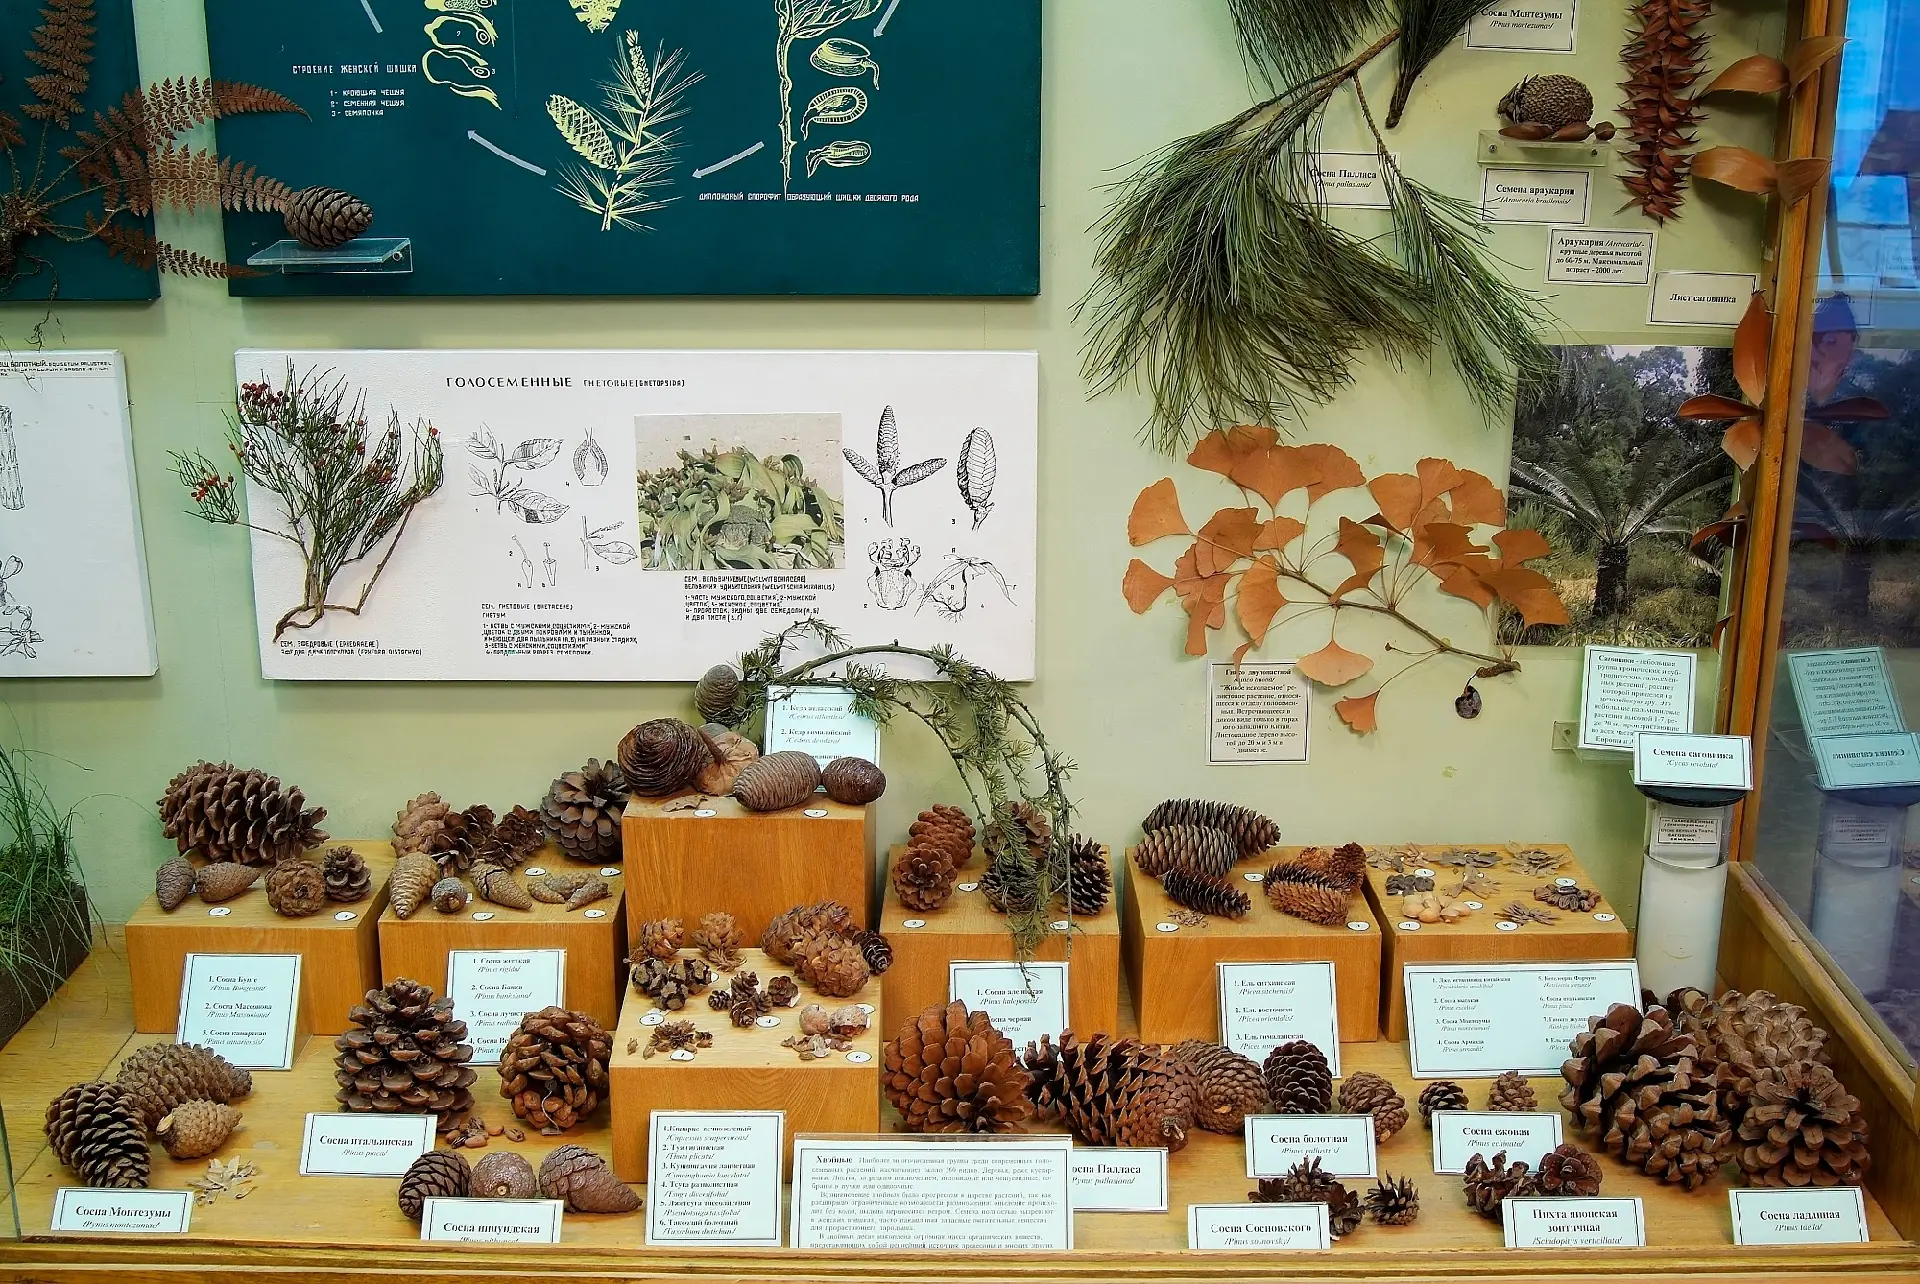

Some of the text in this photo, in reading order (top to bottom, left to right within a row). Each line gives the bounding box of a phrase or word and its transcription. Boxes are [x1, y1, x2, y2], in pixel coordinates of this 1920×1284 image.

[1481, 9, 1562, 20] Сосна Монтезумы
[293, 62, 417, 74] СТРОЕНИЕ ЖЕНСКОЙ ШИШКИ
[1496, 185, 1574, 196] Семена араукарии
[901, 194, 919, 202] РОДА
[1558, 238, 1603, 248] Араукария
[446, 377, 572, 388] ГОЛОСЕМЕННЫЕ
[1653, 748, 1687, 758] Семена
[1463, 1127, 1492, 1135] Сосна
[320, 1135, 348, 1145] Сосна
[1271, 1134, 1348, 1143] Сосна болотная
[1098, 1164, 1141, 1173] Палласа
[76, 1206, 171, 1219] Сосна Монтезумы
[1533, 1209, 1567, 1218] Пихта
[1760, 1211, 1789, 1220] Сосна
[443, 1222, 475, 1233] Сосна
[1211, 1224, 1311, 1233] Сосна Сосновского
